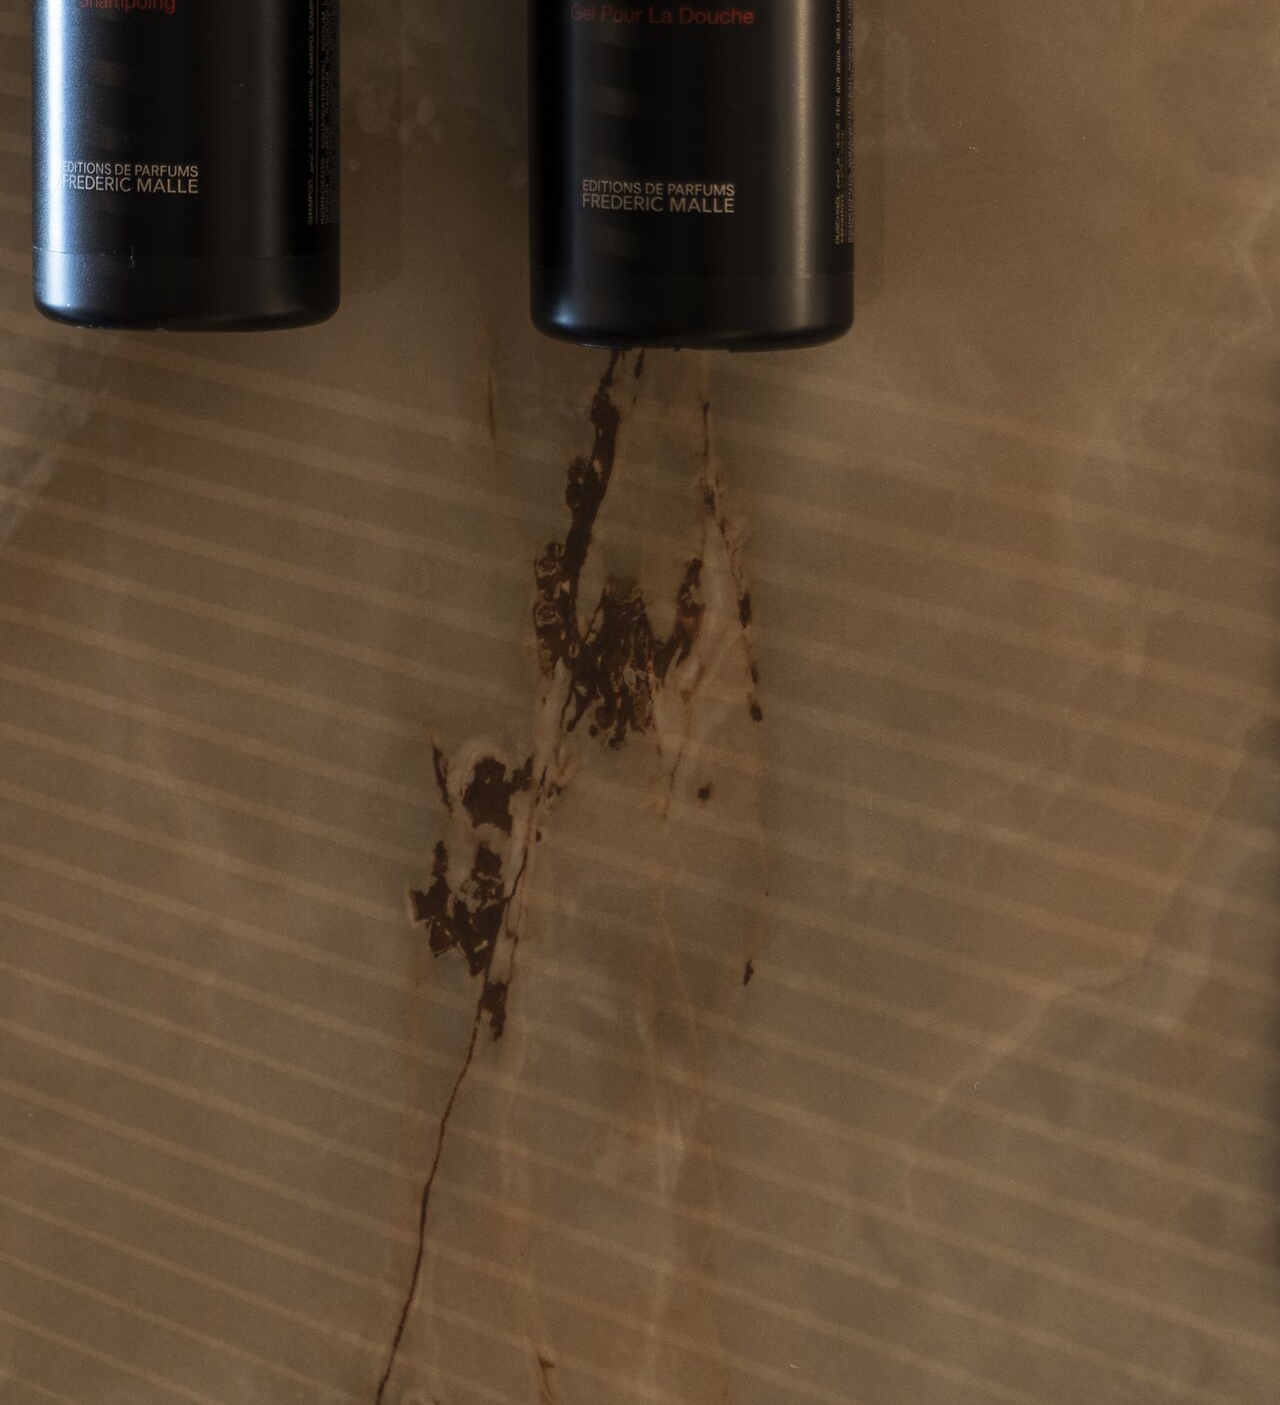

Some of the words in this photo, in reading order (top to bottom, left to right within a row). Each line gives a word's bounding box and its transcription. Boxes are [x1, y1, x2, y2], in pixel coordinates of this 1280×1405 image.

[570, 2, 596, 22] Gel
[600, 4, 644, 23] Pour
[648, 7, 673, 25] La
[679, 7, 755, 26] Douche
[114, 163, 132, 177] DE
[134, 165, 199, 178] PARFUMS
[136, 178, 199, 194] MALLE
[582, 179, 641, 195] EDITIONS
[644, 182, 664, 196] DE
[667, 183, 735, 197] PARFUMS
[582, 193, 664, 212] FREDERIC
[669, 197, 735, 213] MALLE
